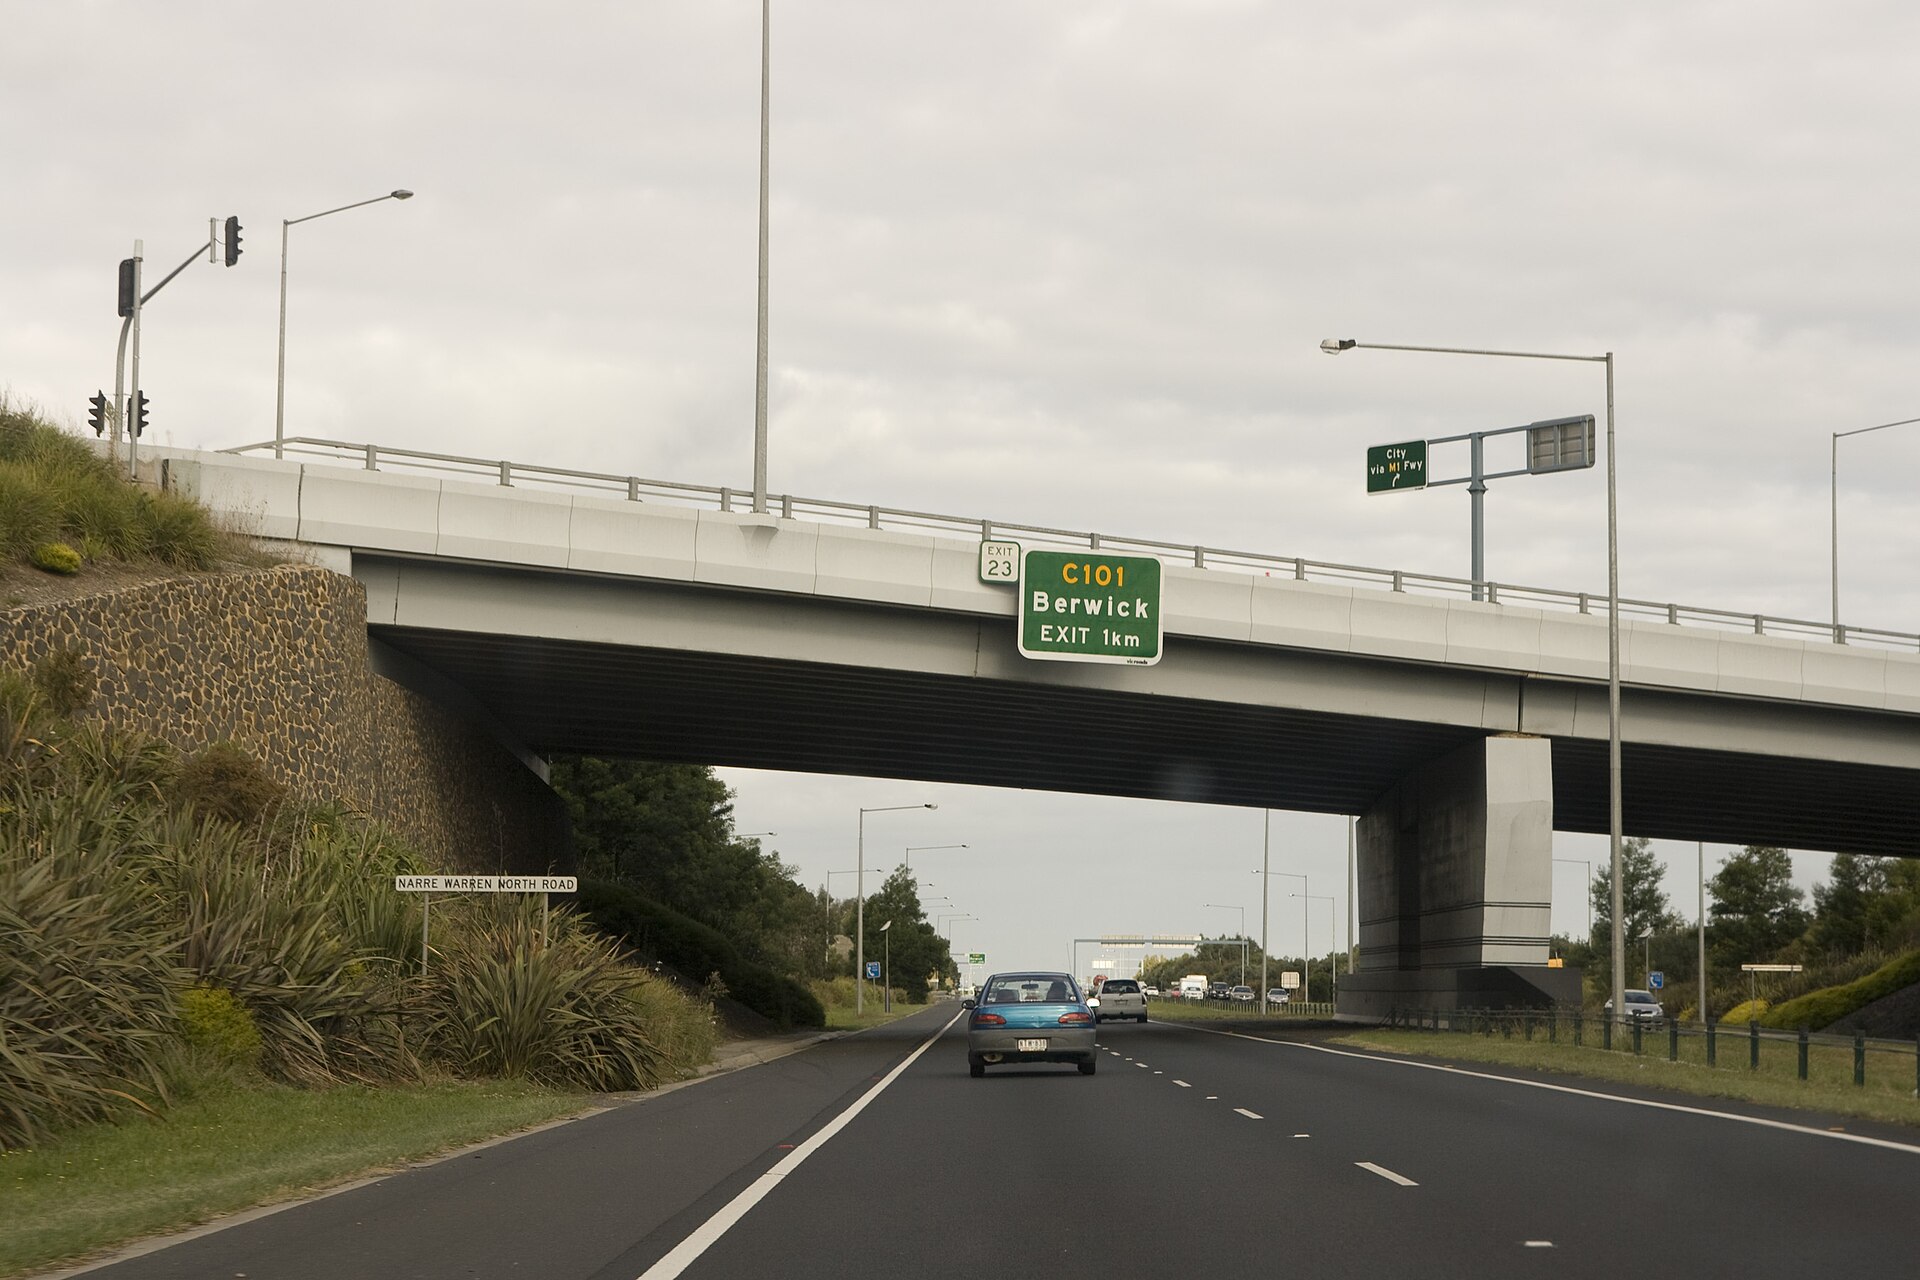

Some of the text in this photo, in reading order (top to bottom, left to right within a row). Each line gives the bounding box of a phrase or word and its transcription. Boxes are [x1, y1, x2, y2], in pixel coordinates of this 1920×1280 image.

[1386, 448, 1406, 460] City
[1370, 460, 1423, 475] via M1 Fwy
[987, 546, 1013, 557] EXIT
[987, 559, 1012, 577] 23
[1062, 562, 1124, 587] C101
[1033, 591, 1149, 619] Berwick
[1040, 624, 1140, 648] EXIT 1km
[398, 878, 574, 890] NARRE WARREN NORTH ROAD
